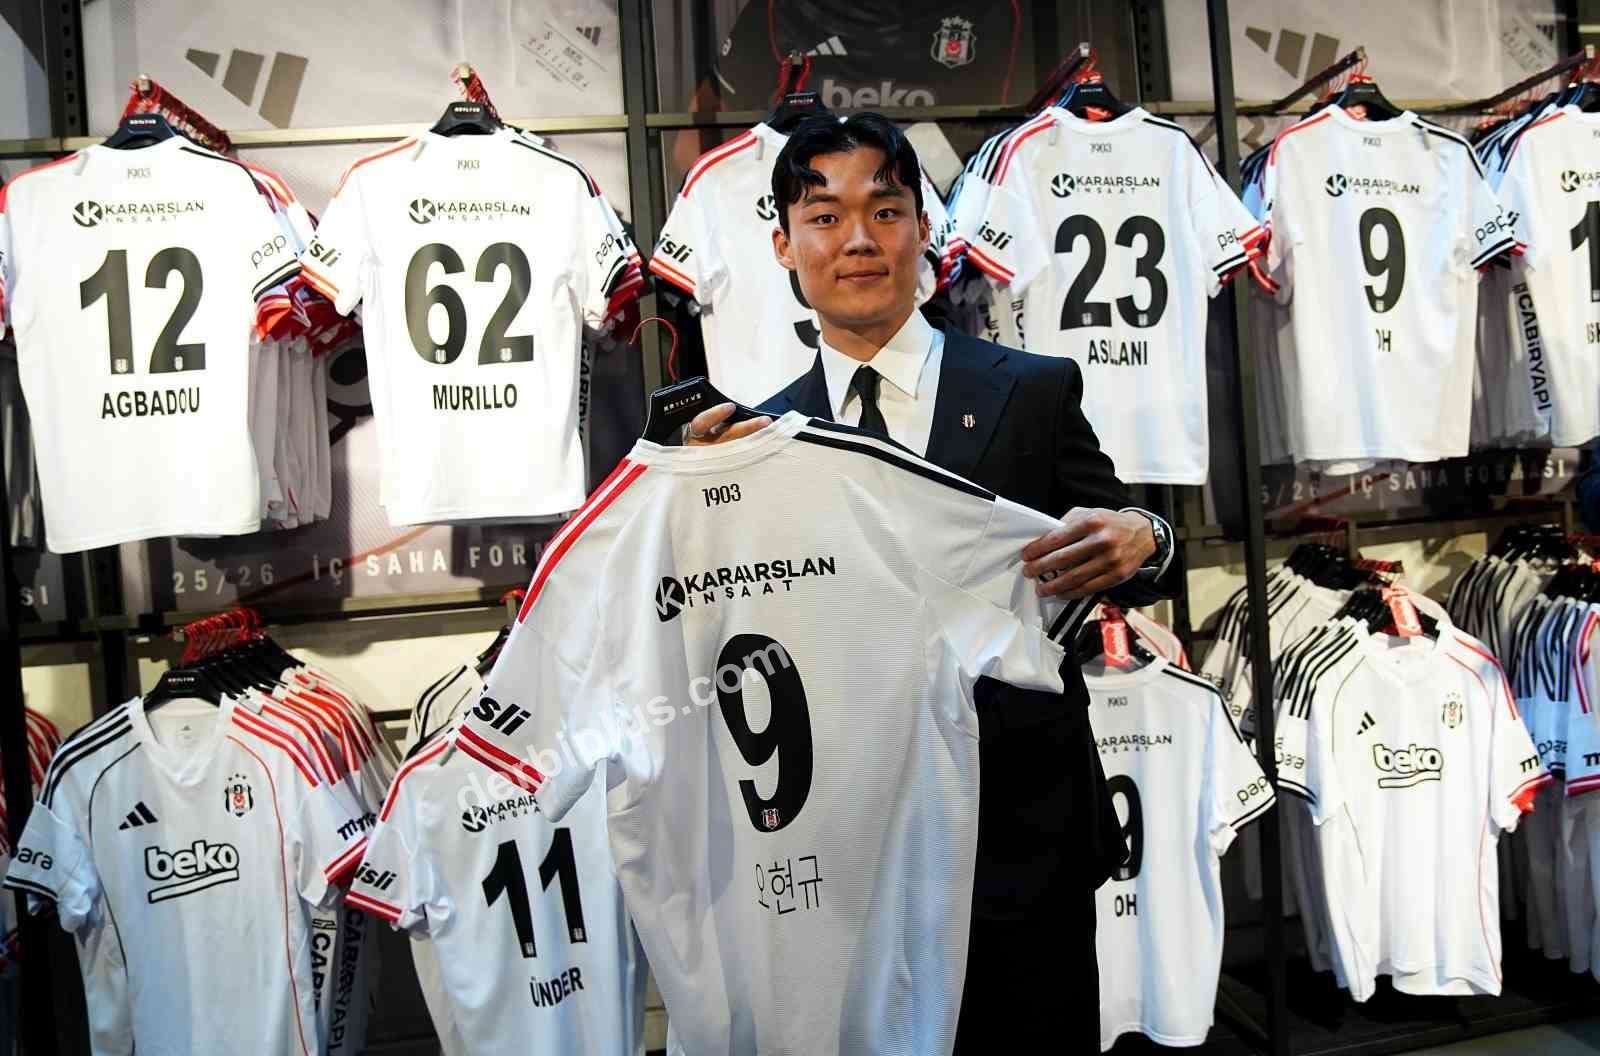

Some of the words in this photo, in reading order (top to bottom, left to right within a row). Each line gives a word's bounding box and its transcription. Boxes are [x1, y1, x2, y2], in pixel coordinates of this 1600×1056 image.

[822, 79, 936, 109] beko
[1054, 214, 1168, 330] 23
[1359, 207, 1406, 313] 9
[80, 247, 206, 374] 12
[405, 242, 534, 365] 62
[1088, 340, 1148, 366] ASLANI
[101, 387, 200, 419] AGBADOU
[433, 383, 518, 410] MURILLO
[702, 484, 742, 508] 1903
[173, 564, 274, 594] 25/26
[367, 549, 448, 577] SAHA
[469, 543, 541, 568] FOR
[473, 684, 532, 736] sli
[716, 633, 814, 833] 9
[1373, 744, 1443, 772] beko
[145, 840, 239, 880] beko
[482, 827, 587, 958] 11
[755, 856, 823, 915] 오현규
[1114, 895, 1137, 917] OH
[530, 967, 585, 1007] ÜNDER
